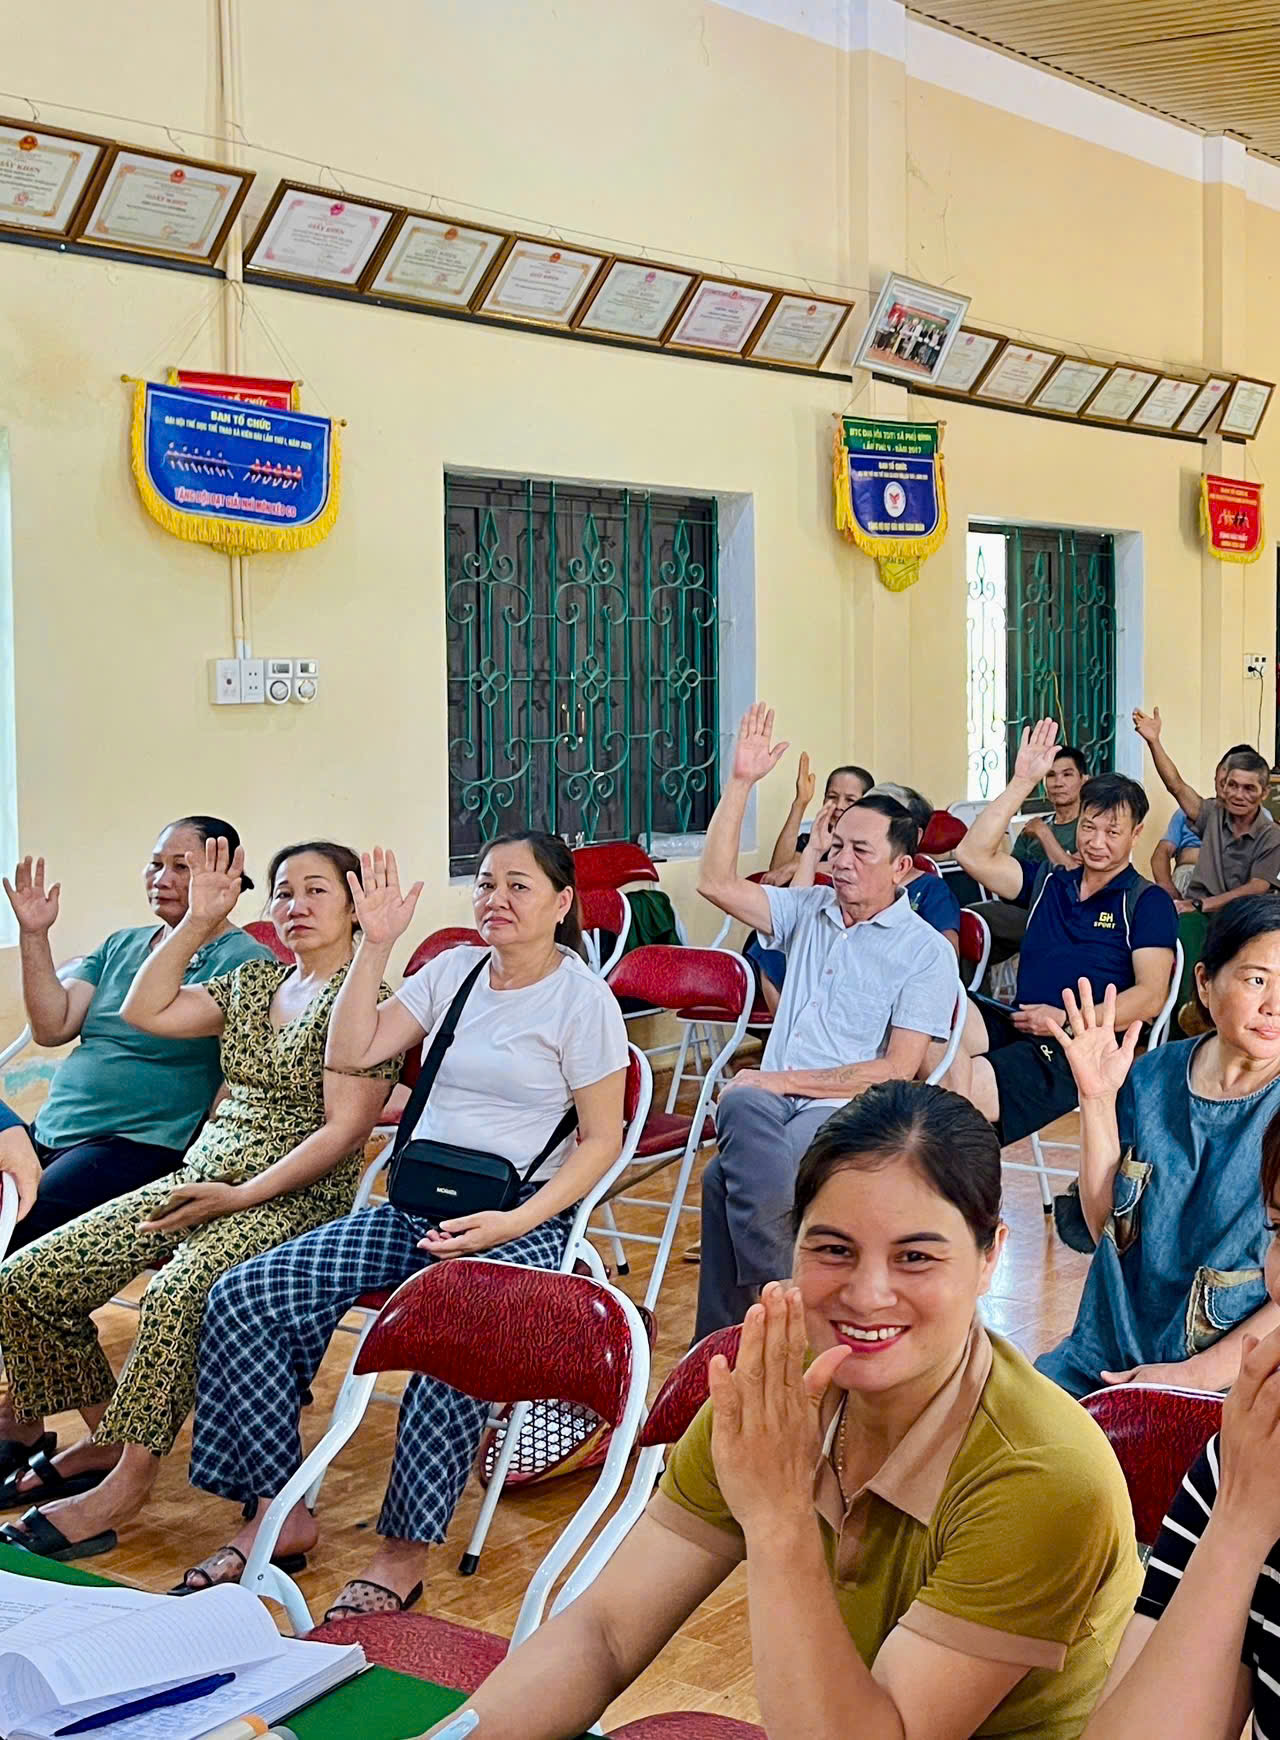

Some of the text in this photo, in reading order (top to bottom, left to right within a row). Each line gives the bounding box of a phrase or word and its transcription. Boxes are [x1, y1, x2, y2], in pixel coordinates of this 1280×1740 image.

[211, 411, 272, 431] BAN TỔ CHỨC
[286, 505, 297, 518] CO
[1099, 911, 1113, 922] GH
[1093, 921, 1116, 929] SPORT
